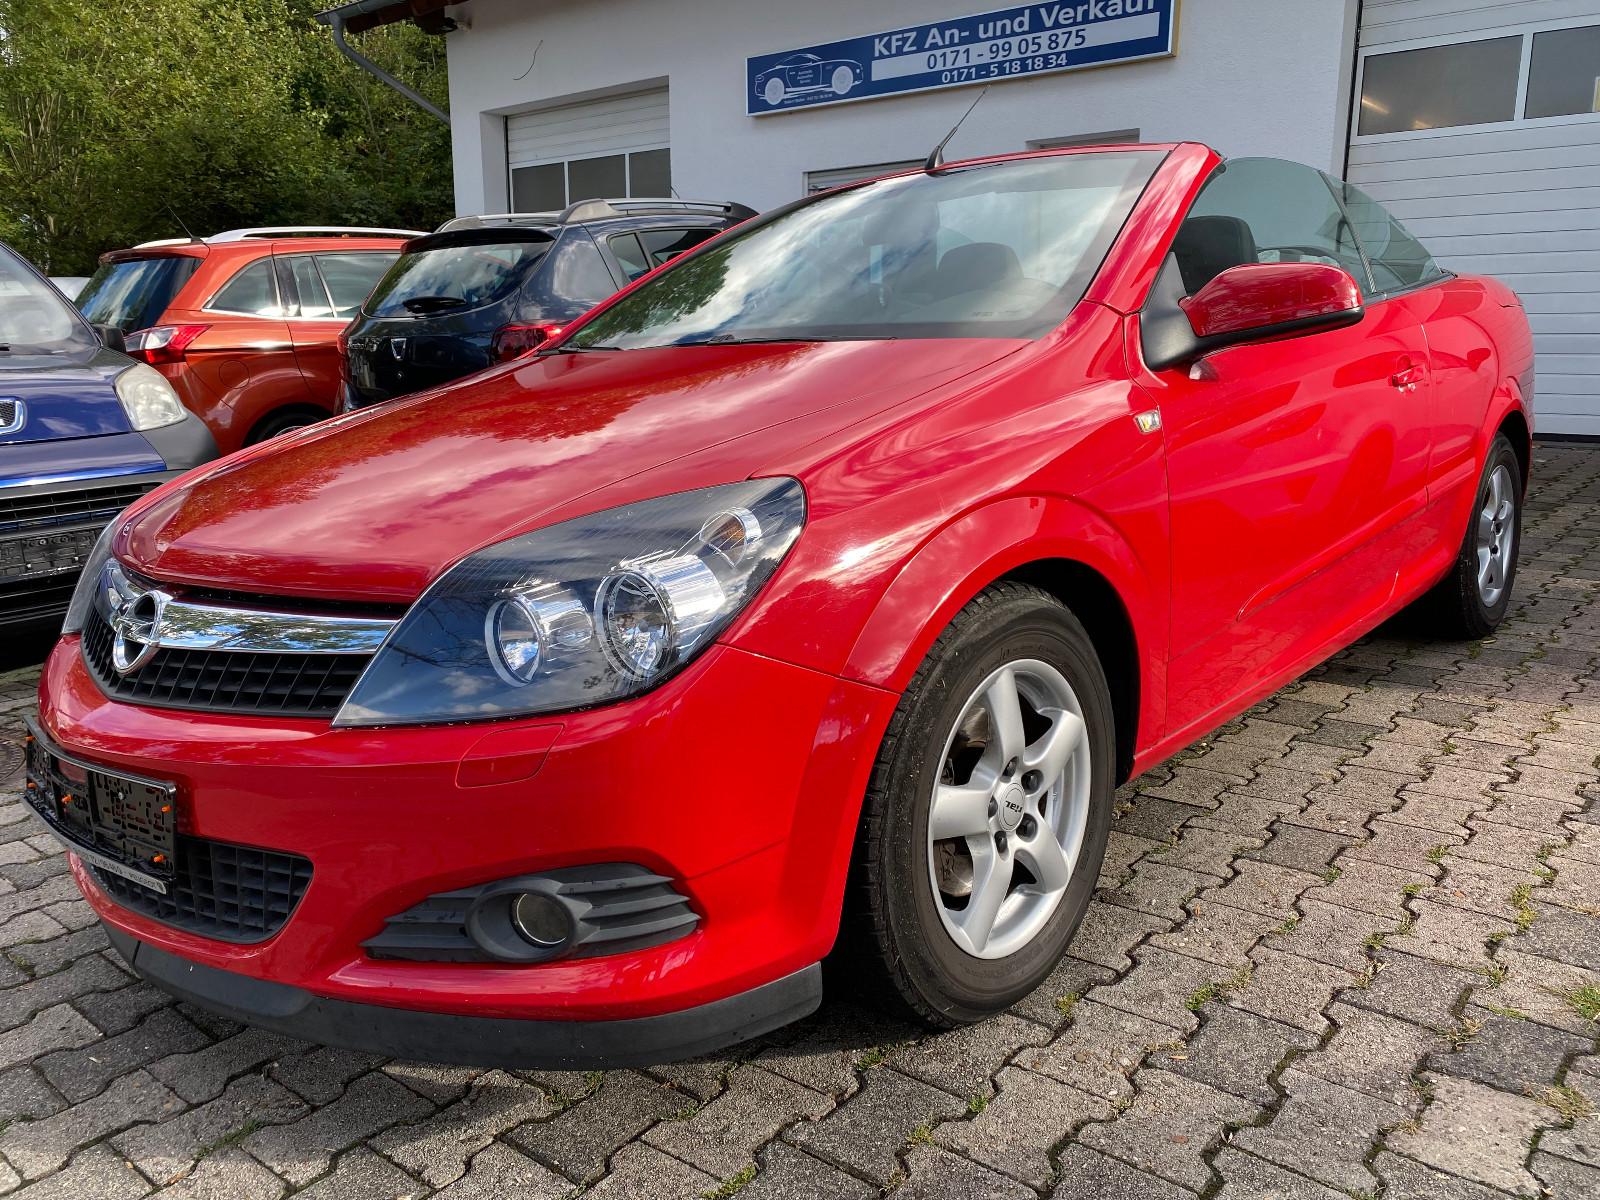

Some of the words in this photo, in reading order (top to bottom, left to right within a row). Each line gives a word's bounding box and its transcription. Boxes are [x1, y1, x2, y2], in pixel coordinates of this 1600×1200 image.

[874, 31, 917, 57] KFZ
[924, 27, 969, 49] An-
[978, 9, 1030, 39] und
[927, 47, 970, 70] 0171
[989, 41, 1012, 60] 99
[1018, 36, 1042, 56] 05
[1048, 28, 1086, 50] 875
[942, 67, 976, 83] 0171
[990, 64, 999, 77] 5
[1003, 60, 1021, 74] 18
[1025, 58, 1044, 71] 18
[1048, 53, 1067, 67] 34
